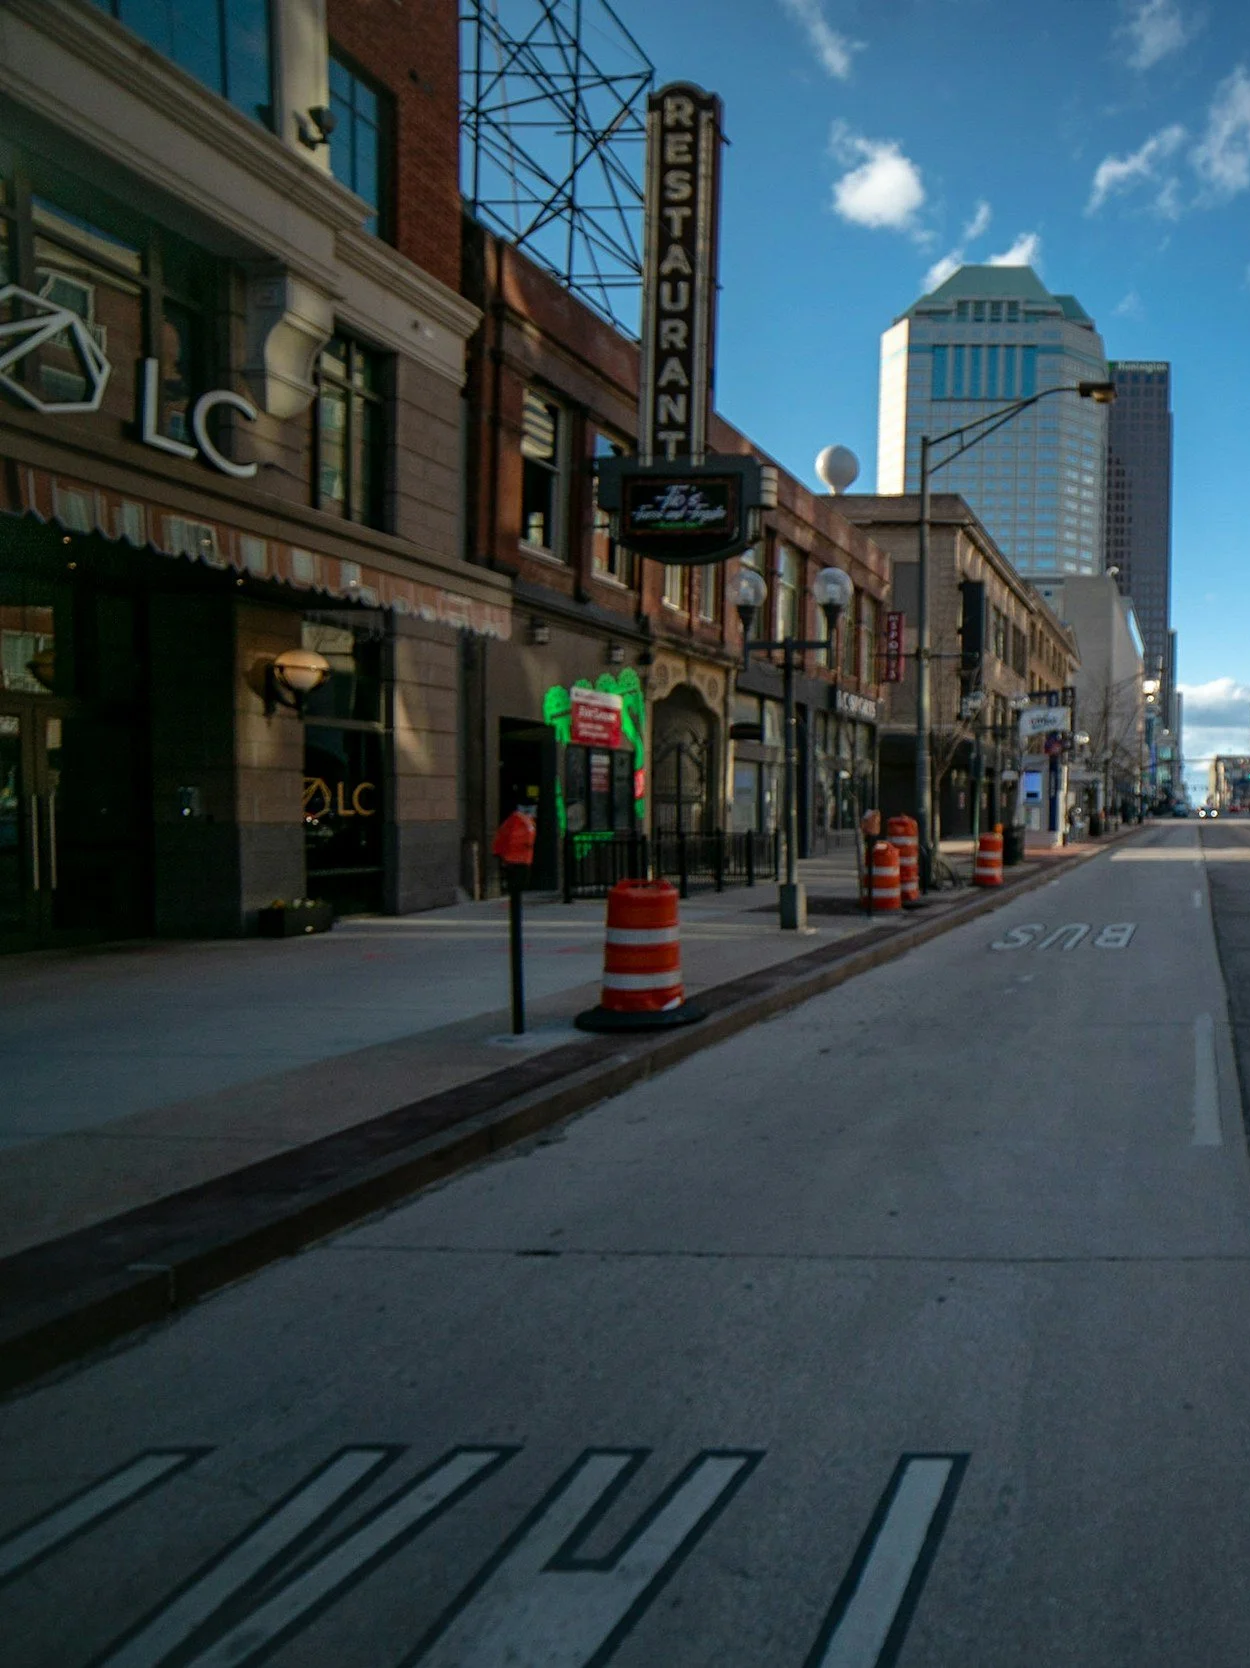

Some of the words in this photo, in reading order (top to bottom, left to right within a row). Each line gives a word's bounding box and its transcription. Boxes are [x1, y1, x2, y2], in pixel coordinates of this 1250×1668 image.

[657, 95, 696, 462] RESTAURANT
[141, 357, 259, 479] LC
[336, 781, 376, 817] LC
[990, 922, 1138, 951] BUS
